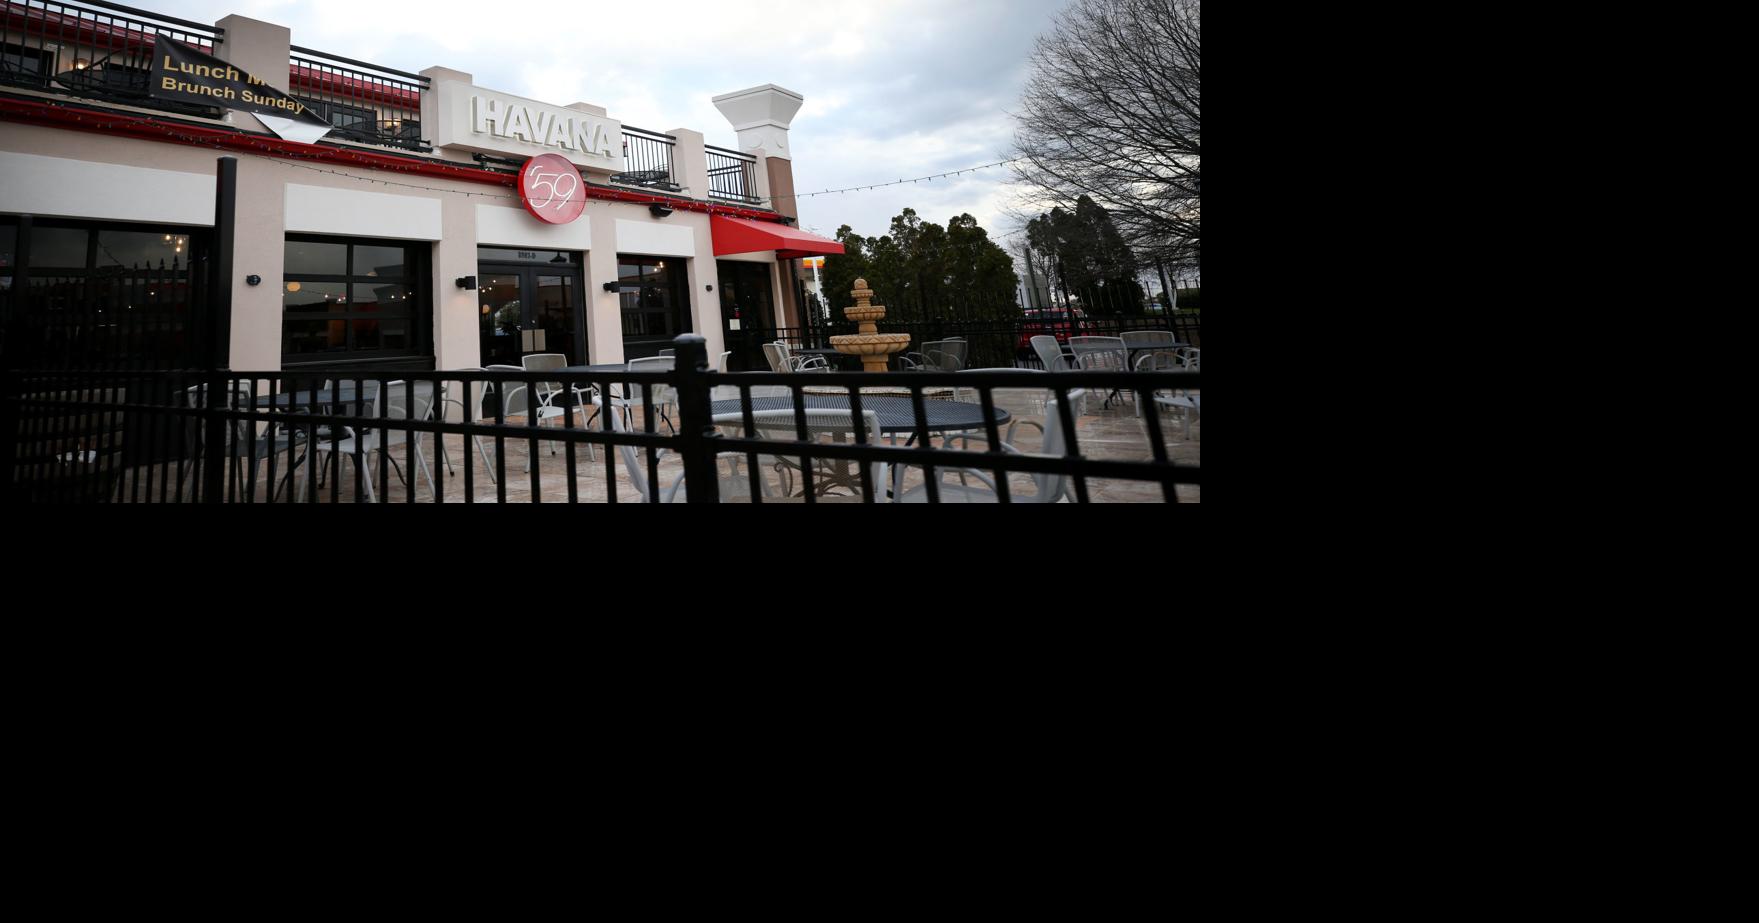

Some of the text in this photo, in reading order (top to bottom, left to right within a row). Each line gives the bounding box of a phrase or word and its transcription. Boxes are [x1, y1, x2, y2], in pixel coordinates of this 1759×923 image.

[163, 55, 239, 82] Lunch
[161, 76, 305, 115] Brunch Sunday
[472, 95, 616, 158] HAVANA
